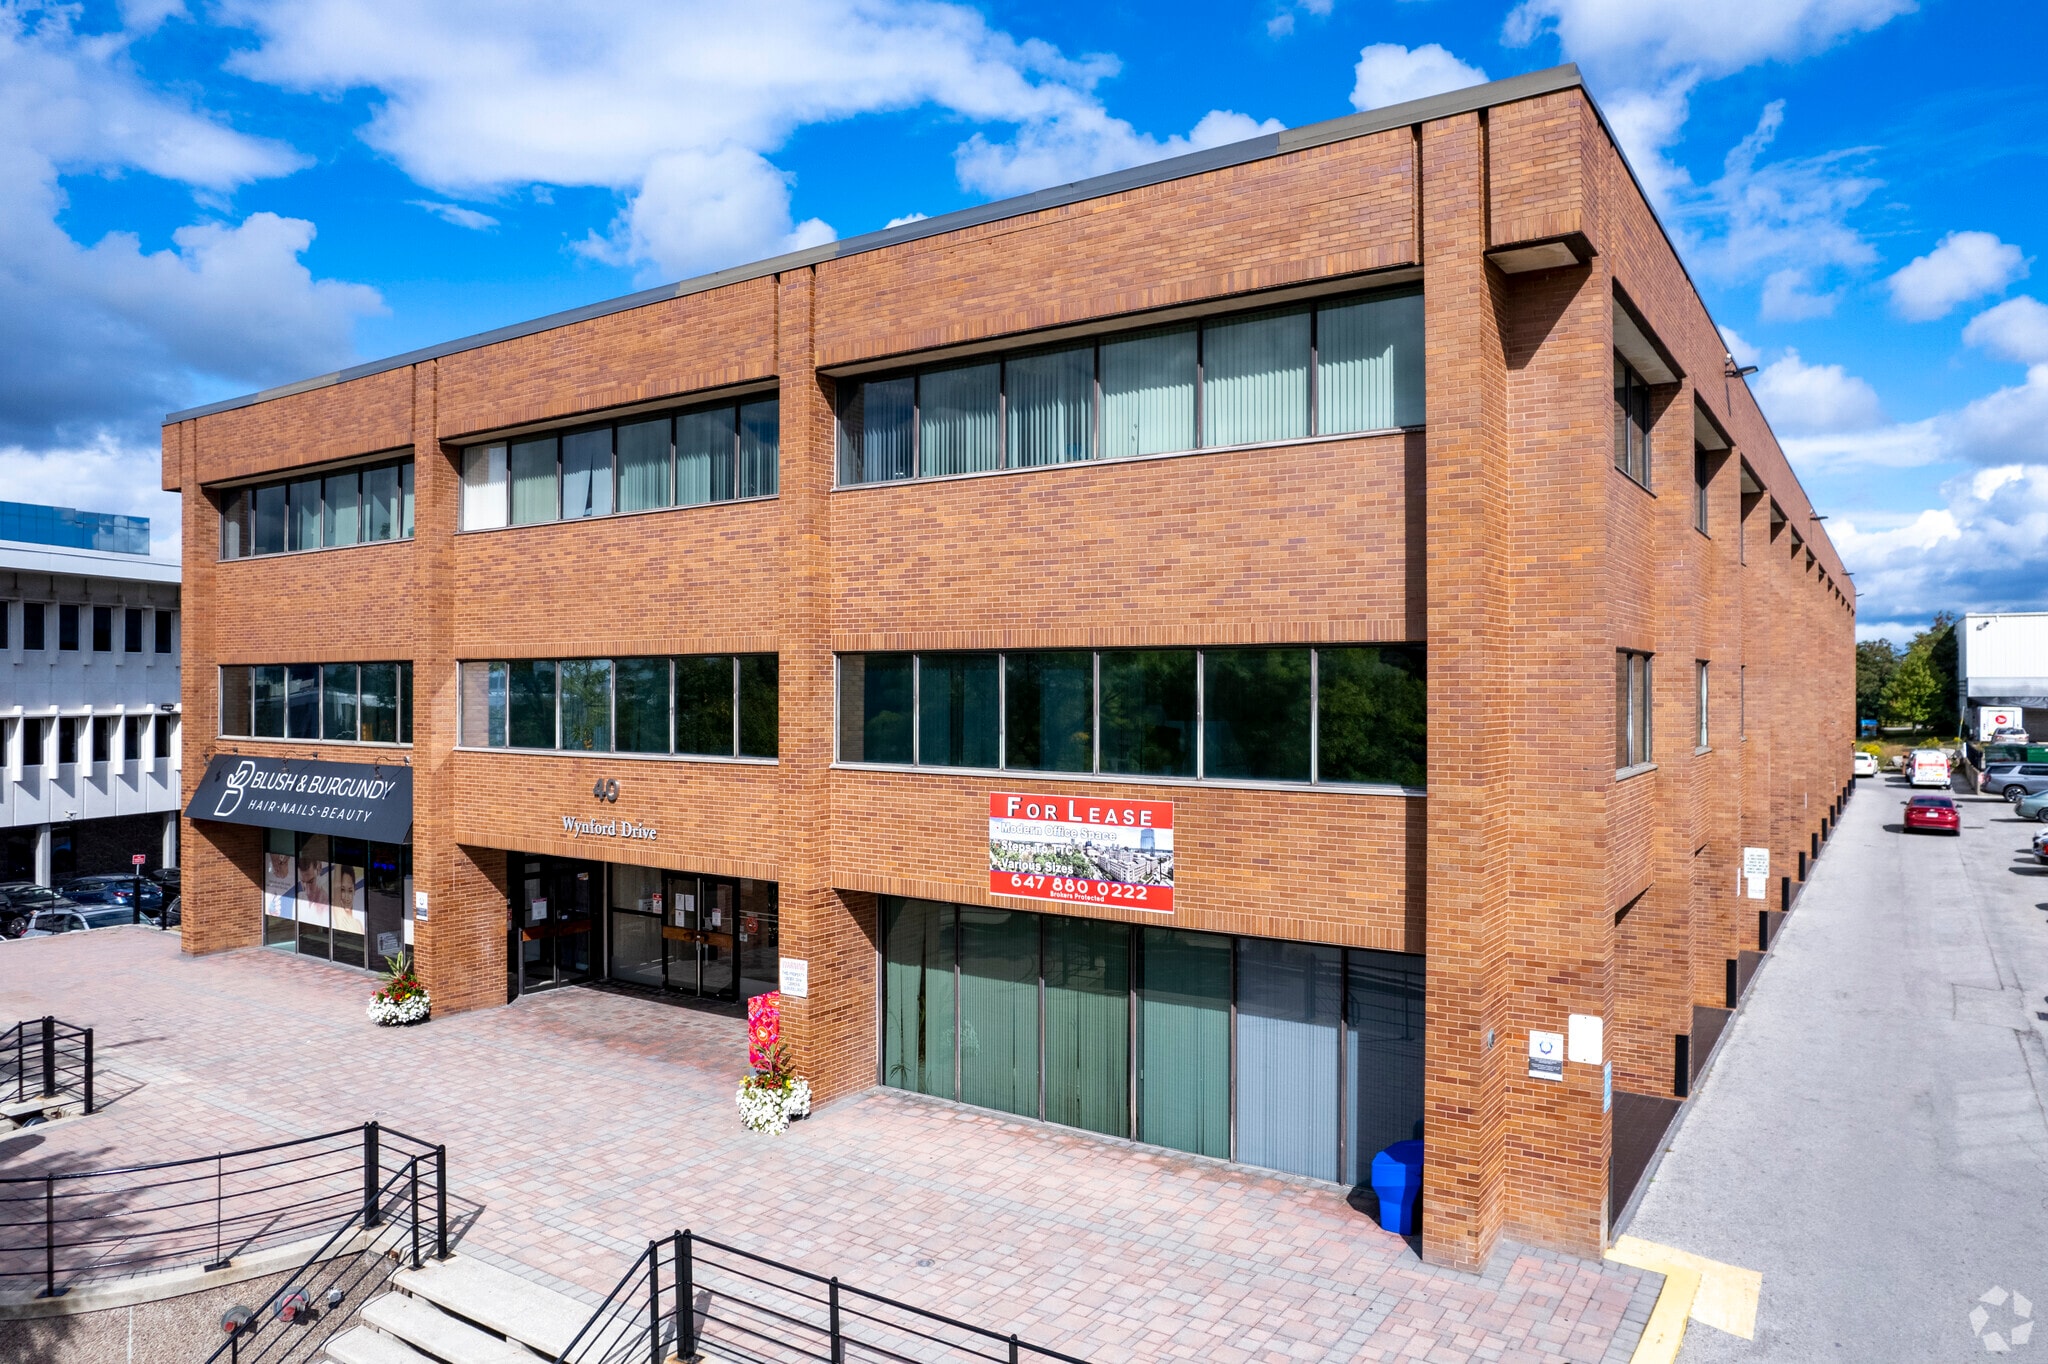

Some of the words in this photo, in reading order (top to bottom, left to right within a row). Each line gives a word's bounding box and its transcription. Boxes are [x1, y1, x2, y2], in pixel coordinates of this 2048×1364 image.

[251, 771, 298, 791] BLUSH
[296, 776, 306, 792] &
[308, 776, 396, 800] BURGUNDY
[593, 778, 620, 803] 40
[1007, 796, 1058, 820] FOR
[1068, 800, 1153, 827] LEASE
[562, 816, 617, 839] Wynford
[621, 821, 657, 841] Drive
[1001, 822, 1042, 835] Modern
[1045, 825, 1078, 838] Office
[1080, 827, 1118, 841] Space
[1001, 839, 1031, 854] Steps
[1034, 843, 1048, 853] To
[1053, 844, 1073, 856] TTC
[1002, 859, 1041, 871] Various
[1045, 862, 1074, 874] Sizes
[1011, 874, 1045, 890] 647
[1052, 877, 1088, 894] 880
[1097, 882, 1148, 900] 0222
[1050, 890, 1073, 899] Brokers
[1074, 892, 1105, 902] Protected
